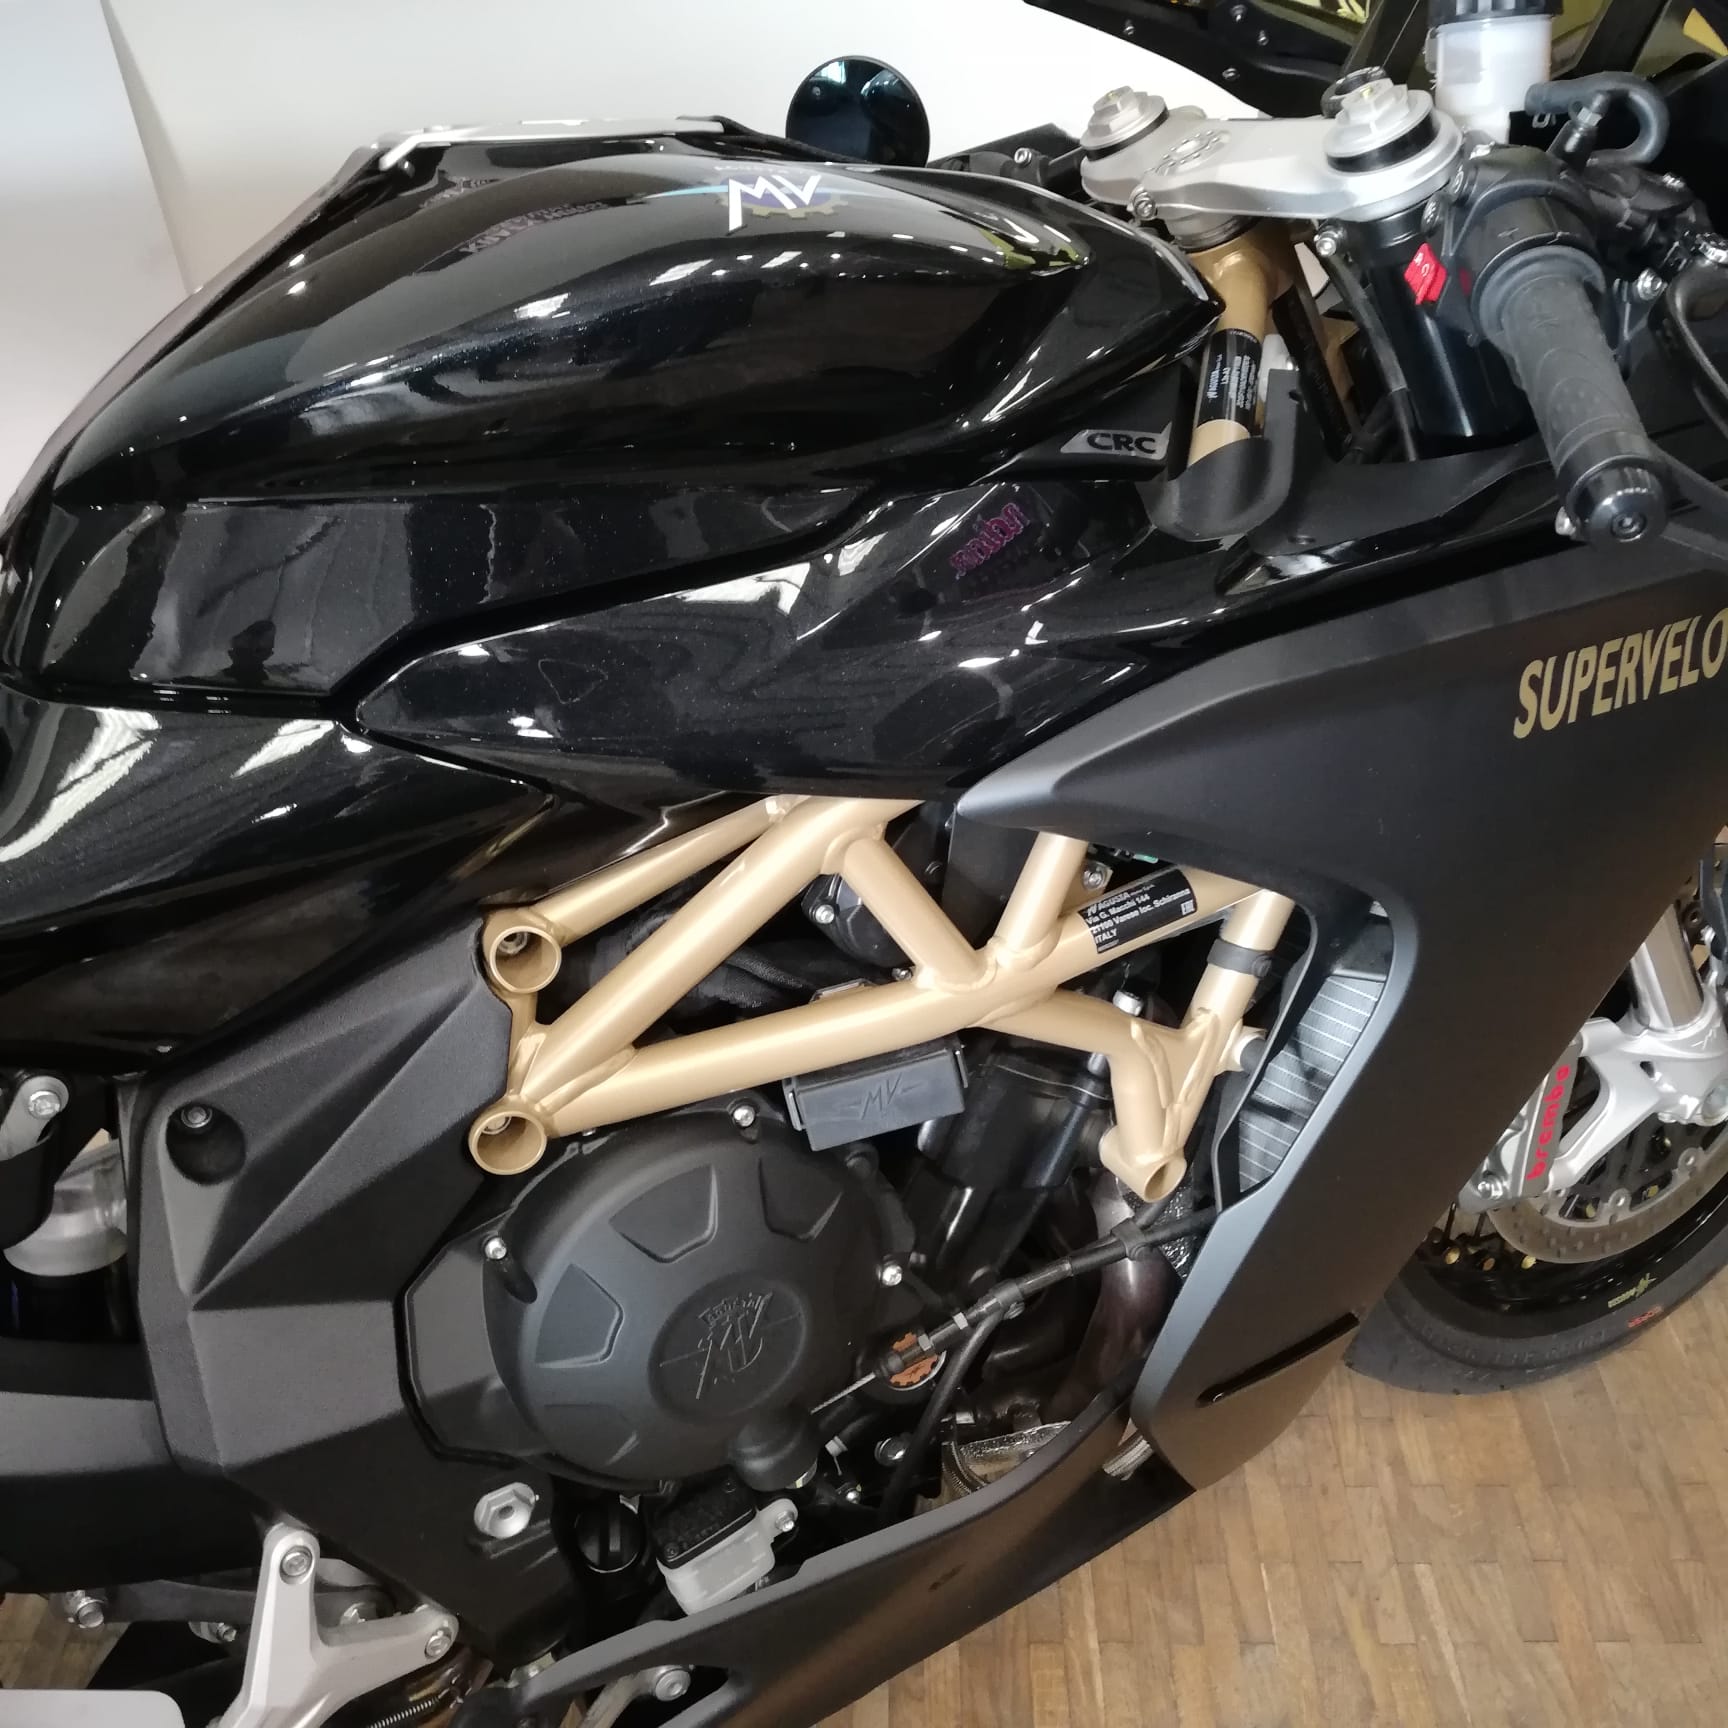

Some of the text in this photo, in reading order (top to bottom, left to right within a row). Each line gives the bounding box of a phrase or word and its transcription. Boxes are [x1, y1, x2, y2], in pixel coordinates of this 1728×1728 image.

[729, 175, 822, 232] MV
[1087, 433, 1156, 454] CRC
[1513, 608, 1728, 739] SUPERVELO
[1098, 892, 1131, 910] AGUSTA
[1086, 914, 1100, 925] Via
[1095, 928, 1118, 944] ITALY
[1525, 1064, 1571, 1180] brembo
